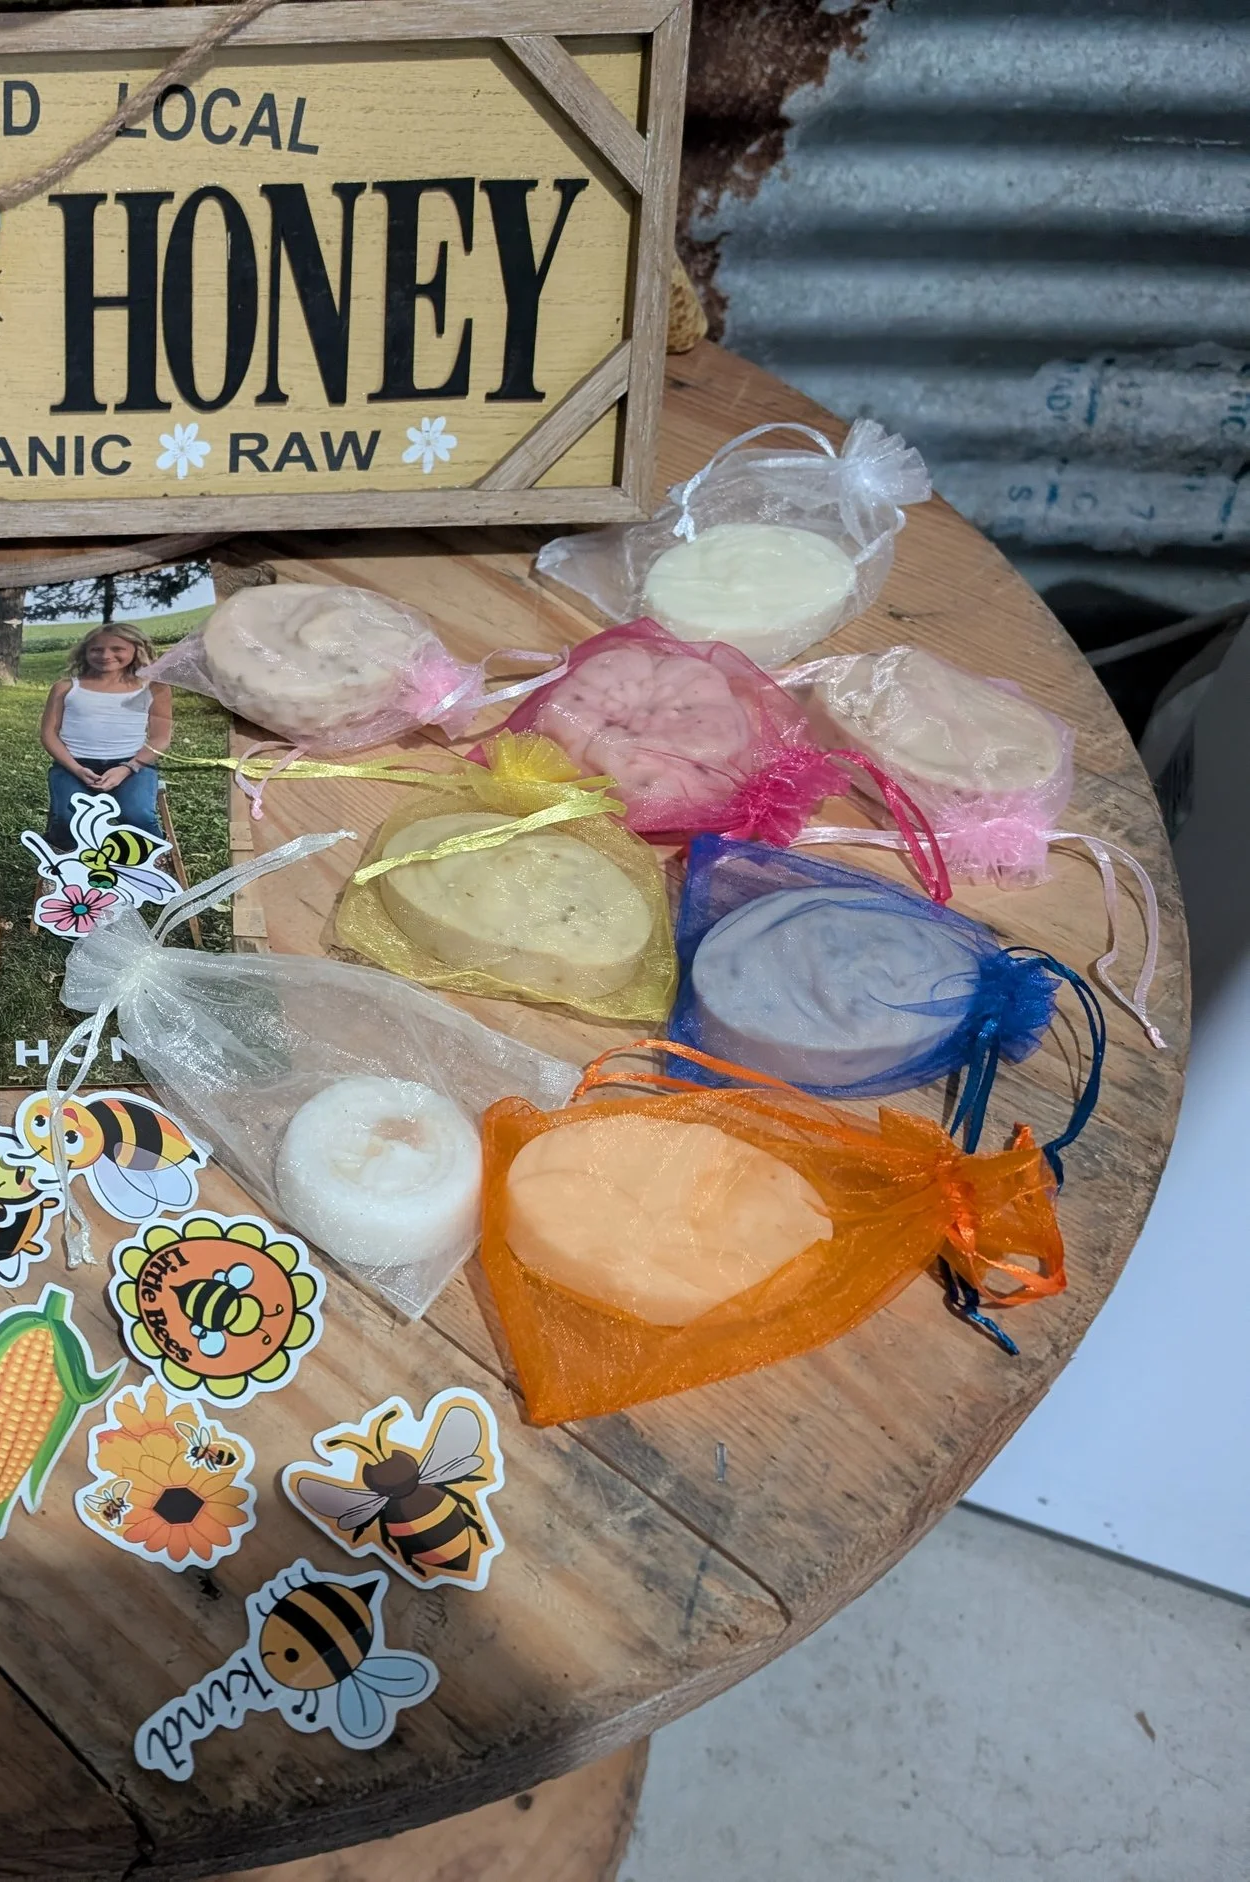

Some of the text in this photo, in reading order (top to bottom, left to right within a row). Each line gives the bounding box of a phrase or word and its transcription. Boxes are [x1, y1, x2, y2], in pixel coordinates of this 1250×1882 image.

[115, 82, 320, 155] LOCAL
[48, 177, 590, 414] HONEY
[228, 429, 382, 474] RAW
[15, 1036, 140, 1067] HON
[141, 1246, 193, 1364] Little Bees
[146, 1656, 274, 1770] kind
